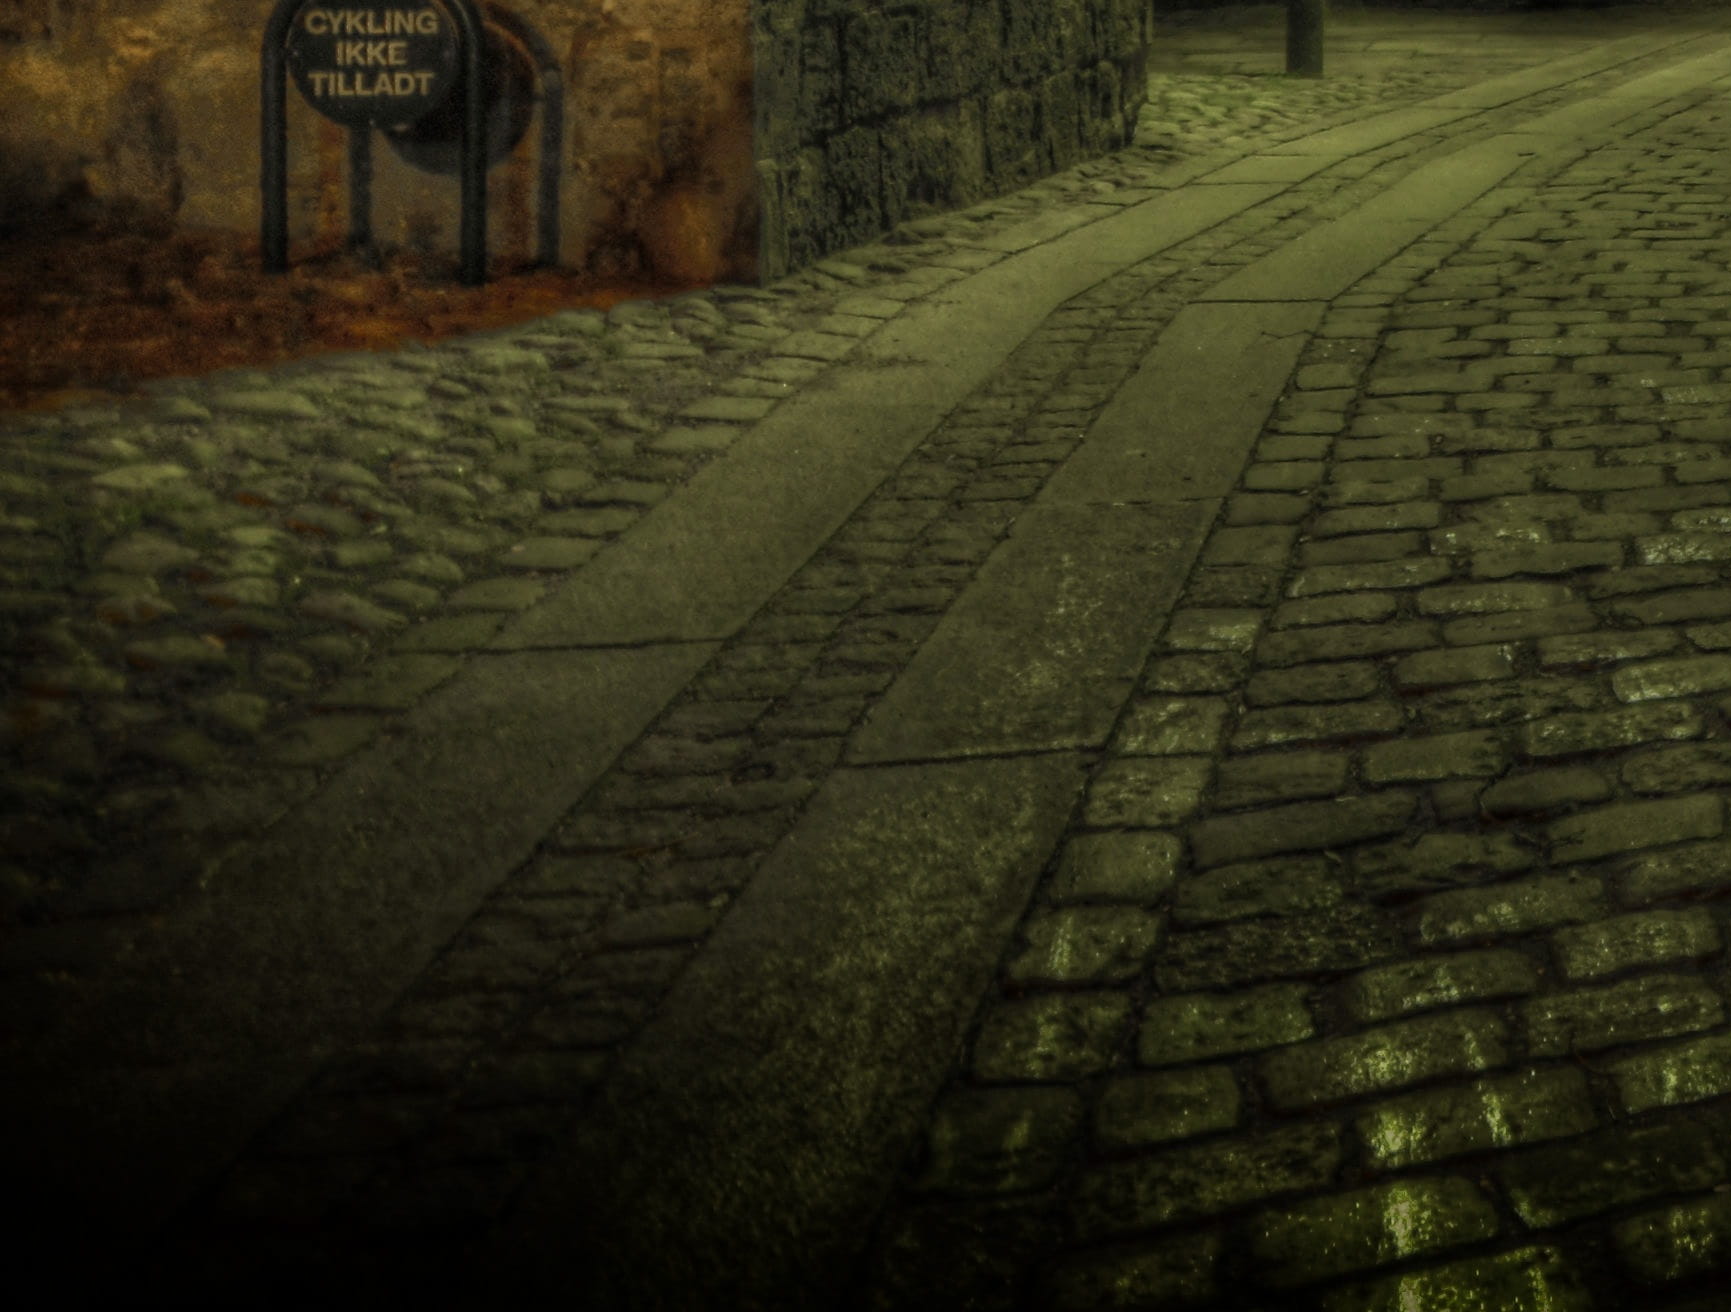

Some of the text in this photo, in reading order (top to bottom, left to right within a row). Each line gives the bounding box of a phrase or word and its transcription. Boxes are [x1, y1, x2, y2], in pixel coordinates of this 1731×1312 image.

[304, 9, 439, 35] CYKLING
[335, 41, 408, 66] IKKE
[307, 72, 435, 96] TILLADT
